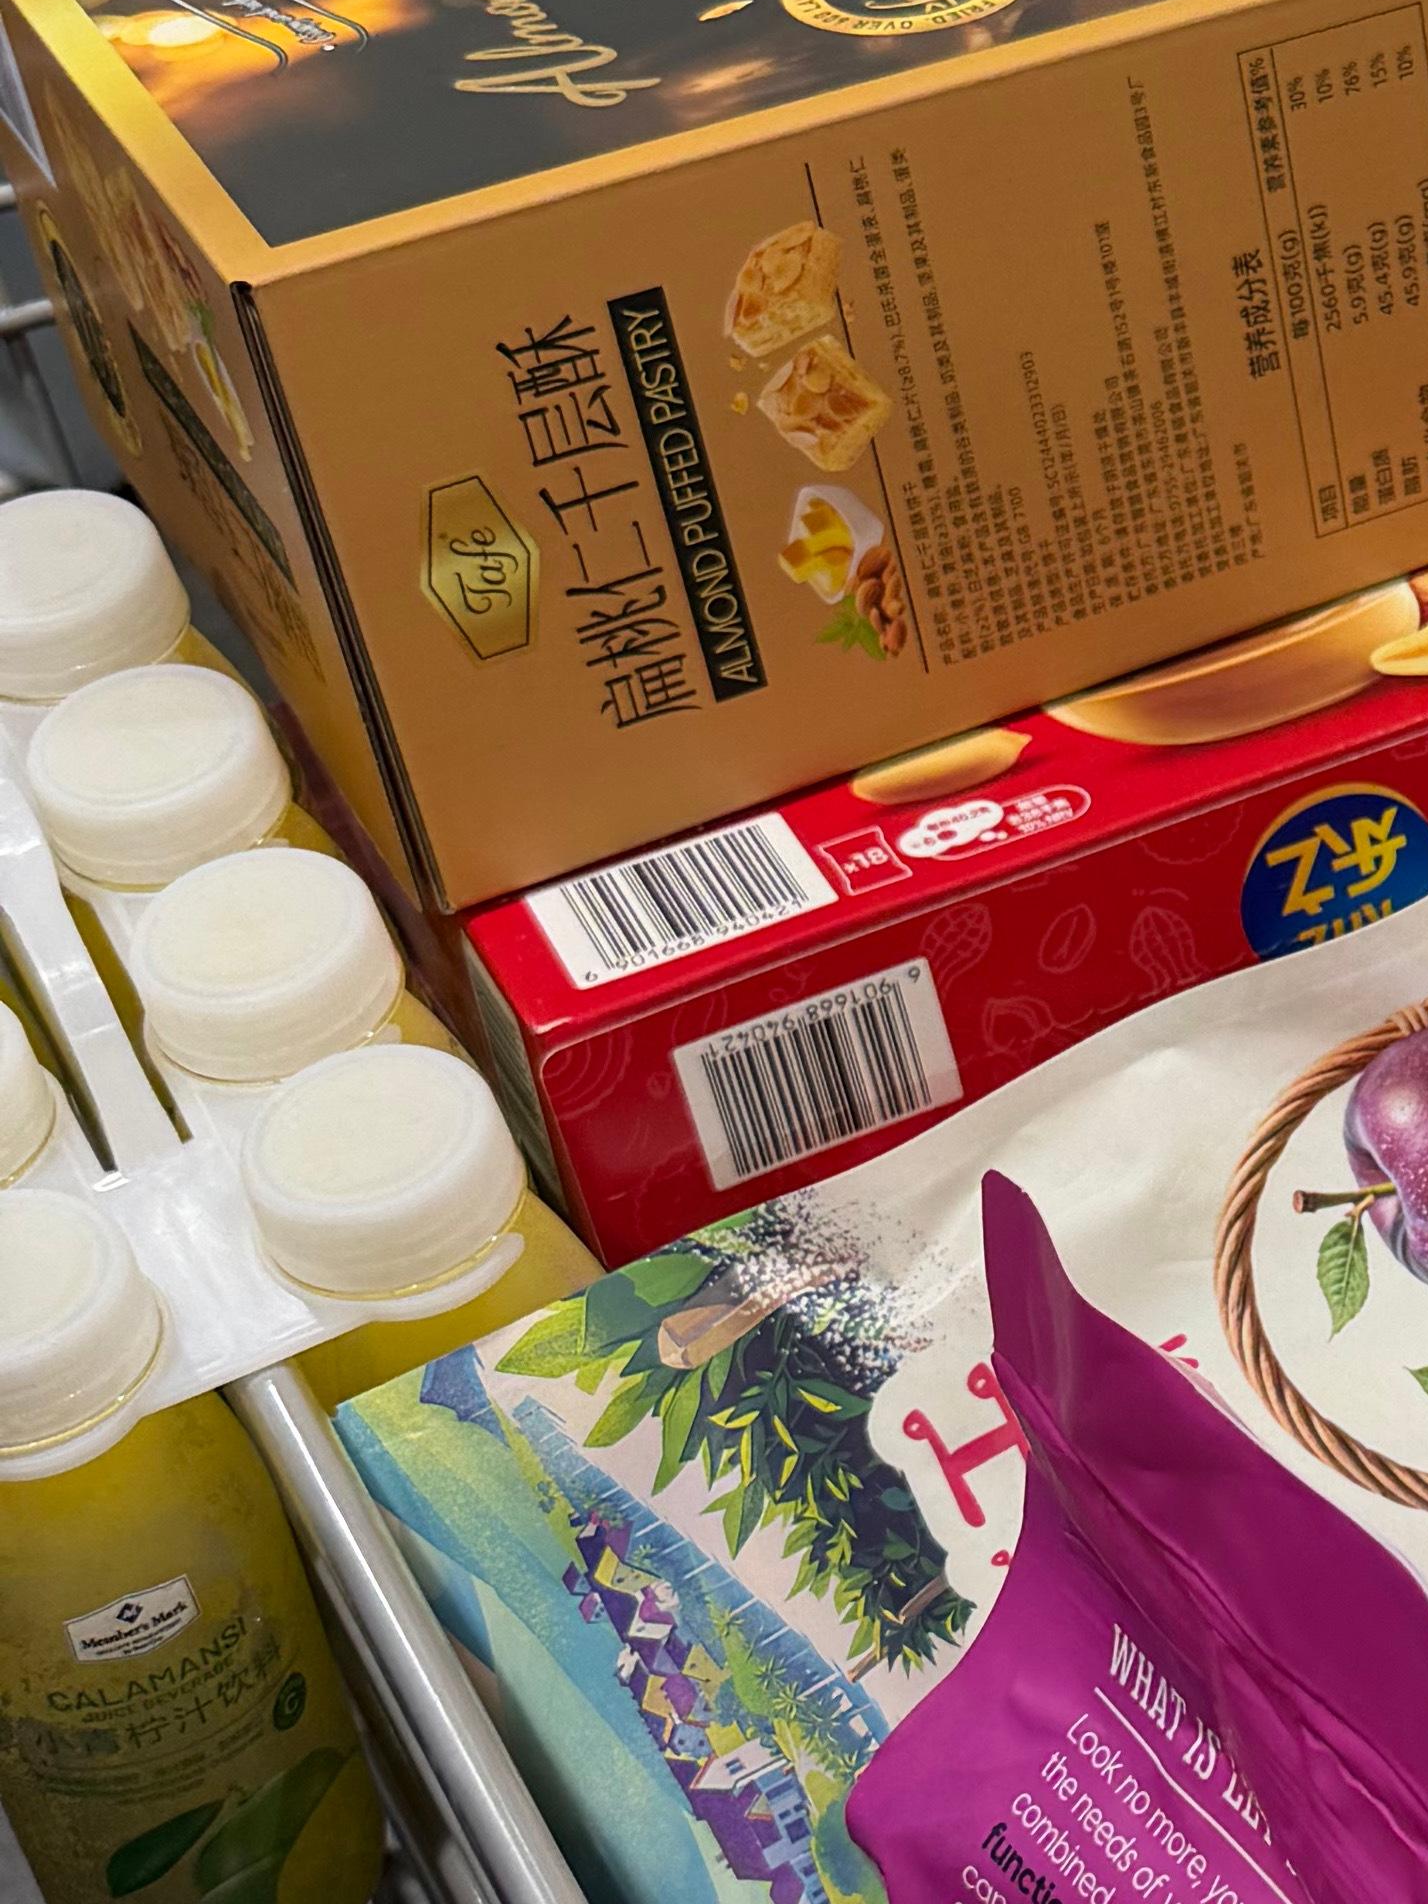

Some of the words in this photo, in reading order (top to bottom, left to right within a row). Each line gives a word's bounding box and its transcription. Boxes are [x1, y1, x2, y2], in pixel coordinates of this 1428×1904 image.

[1245, 55, 1288, 195] 营养素参考值%
[1229, 246, 1282, 381] 营养成分表
[1274, 226, 1313, 342] 每100克(g)
[1339, 240, 1373, 327] 5.9克(g)
[1365, 218, 1399, 319] 45.4克(g)
[1392, 210, 1426, 309] 45.9克(g)
[618, 299, 690, 425] PASTRY
[486, 306, 704, 743] 扁桃仁千层酥
[652, 422, 721, 546] PUFFED
[1316, 482, 1341, 524] 项目
[687, 545, 761, 692] ALMOND
[582, 970, 599, 985] 6
[617, 934, 707, 973] 901668
[715, 898, 804, 939] 940421
[906, 965, 922, 985] 6
[702, 1015, 799, 1063] 940421
[806, 980, 894, 1025] 901668
[47, 1617, 248, 1712] CALAMANSI
[81, 1621, 151, 1651] Member's
[151, 1601, 188, 1626] Mark
[1109, 1622, 1186, 1739] WHAT
[1040, 1751, 1078, 1801] the
[1072, 1793, 1138, 1872] needs
[1066, 1713, 1123, 1785] Look
[1115, 1776, 1151, 1815] no
[1145, 1806, 1207, 1888] more,
